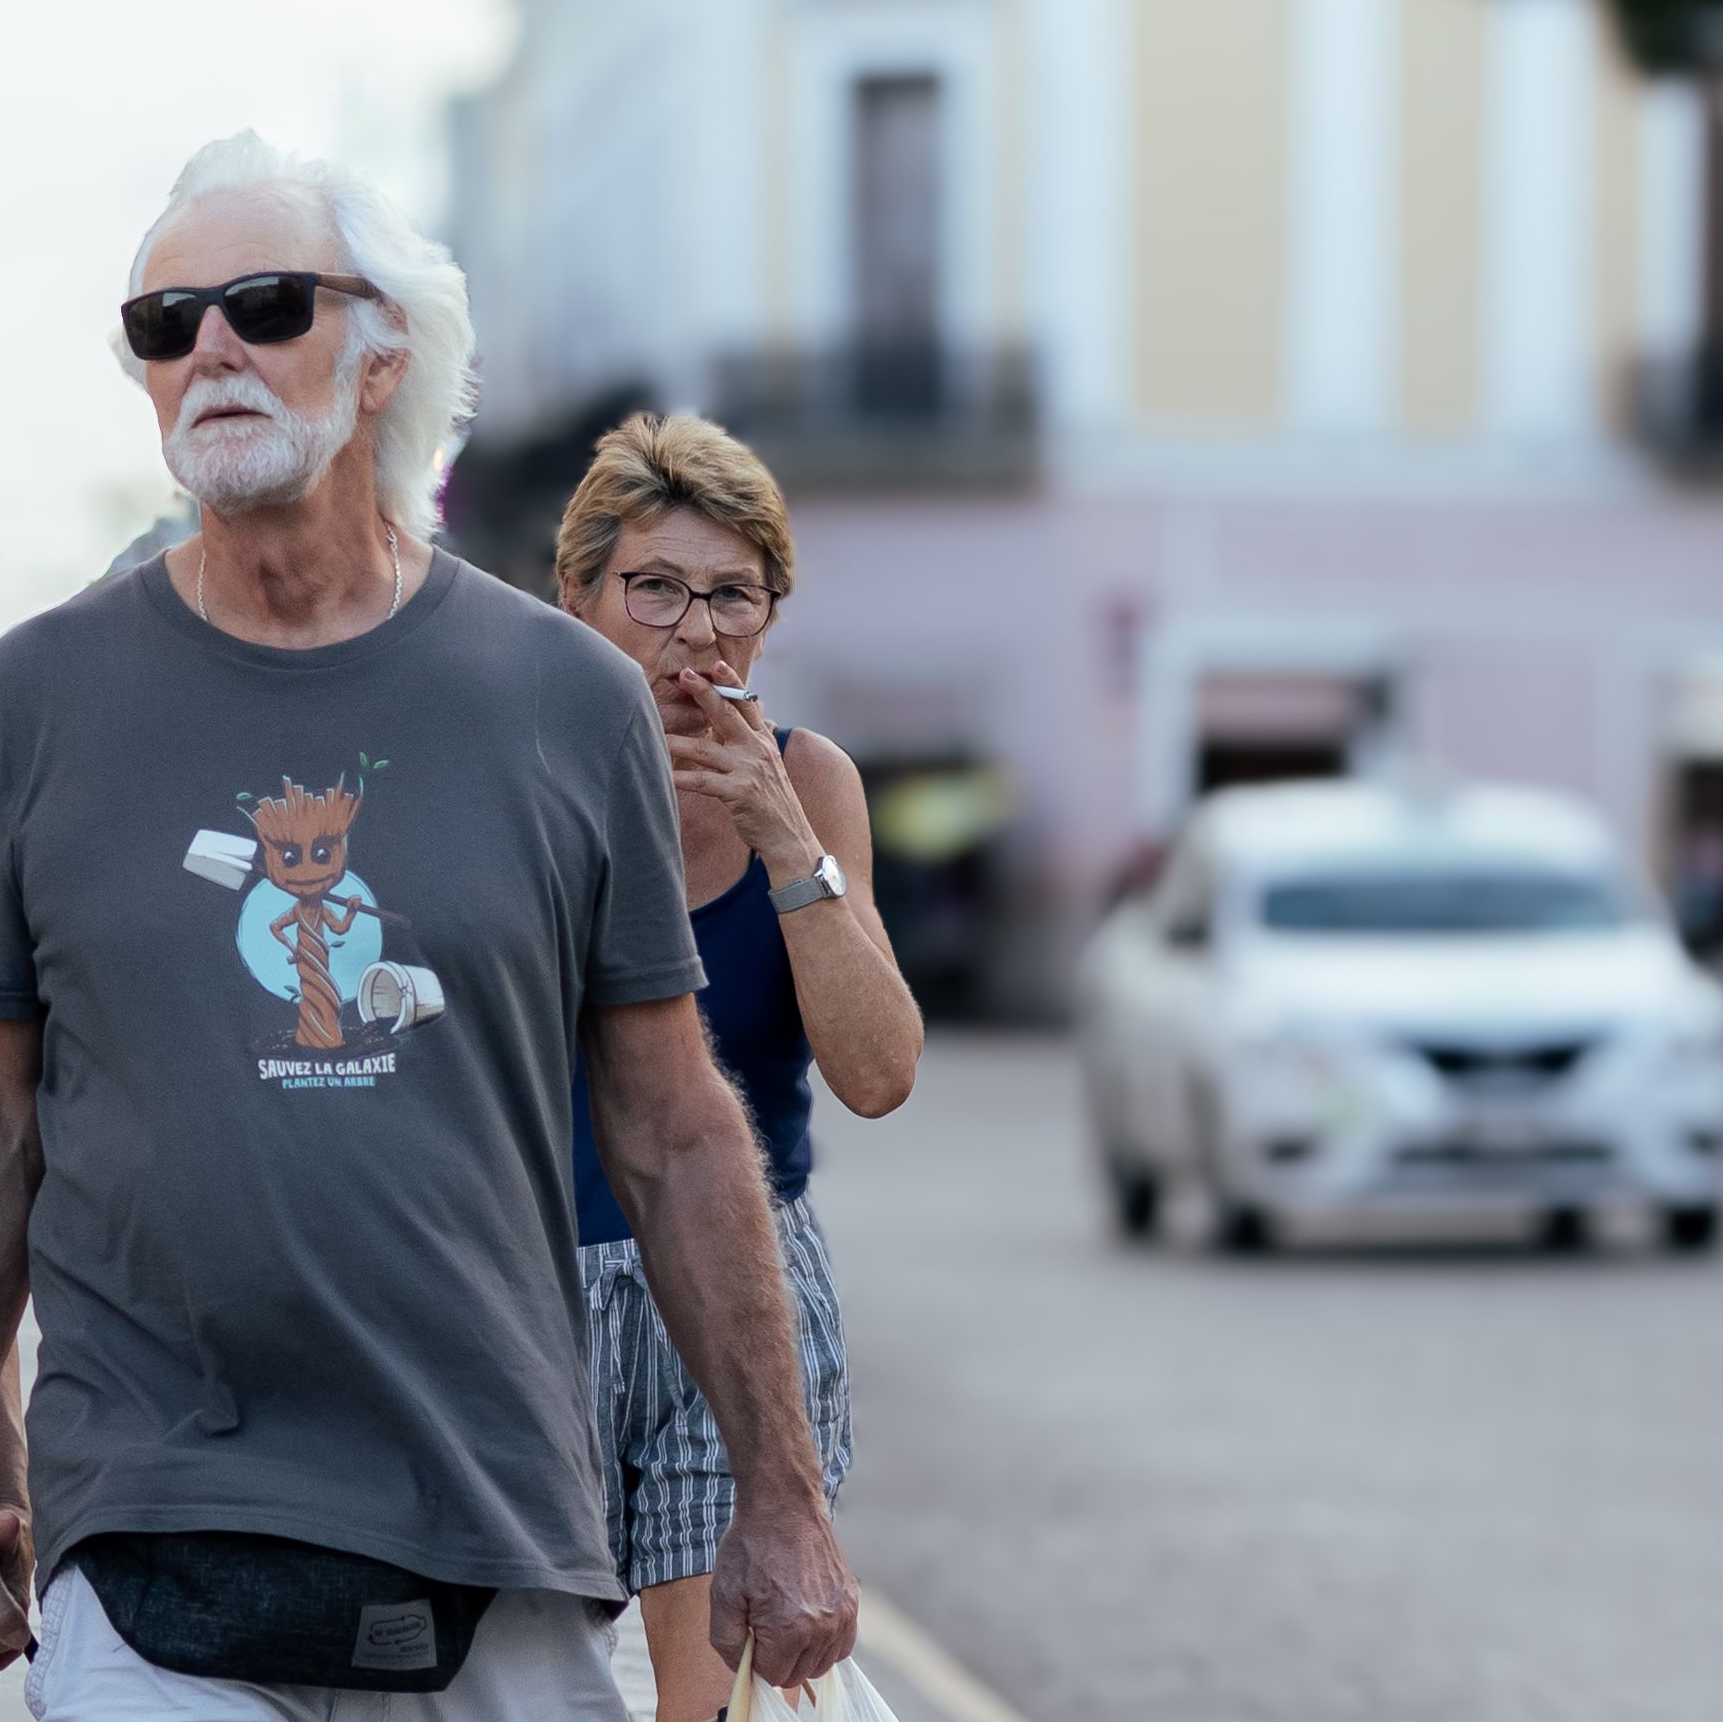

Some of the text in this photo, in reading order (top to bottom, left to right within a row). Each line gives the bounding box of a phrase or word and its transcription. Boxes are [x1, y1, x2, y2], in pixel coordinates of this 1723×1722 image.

[257, 1053, 396, 1079] SAUVEZ LA GALAXIE
[281, 1075, 375, 1089] PLANTEZ UN ARBRE
